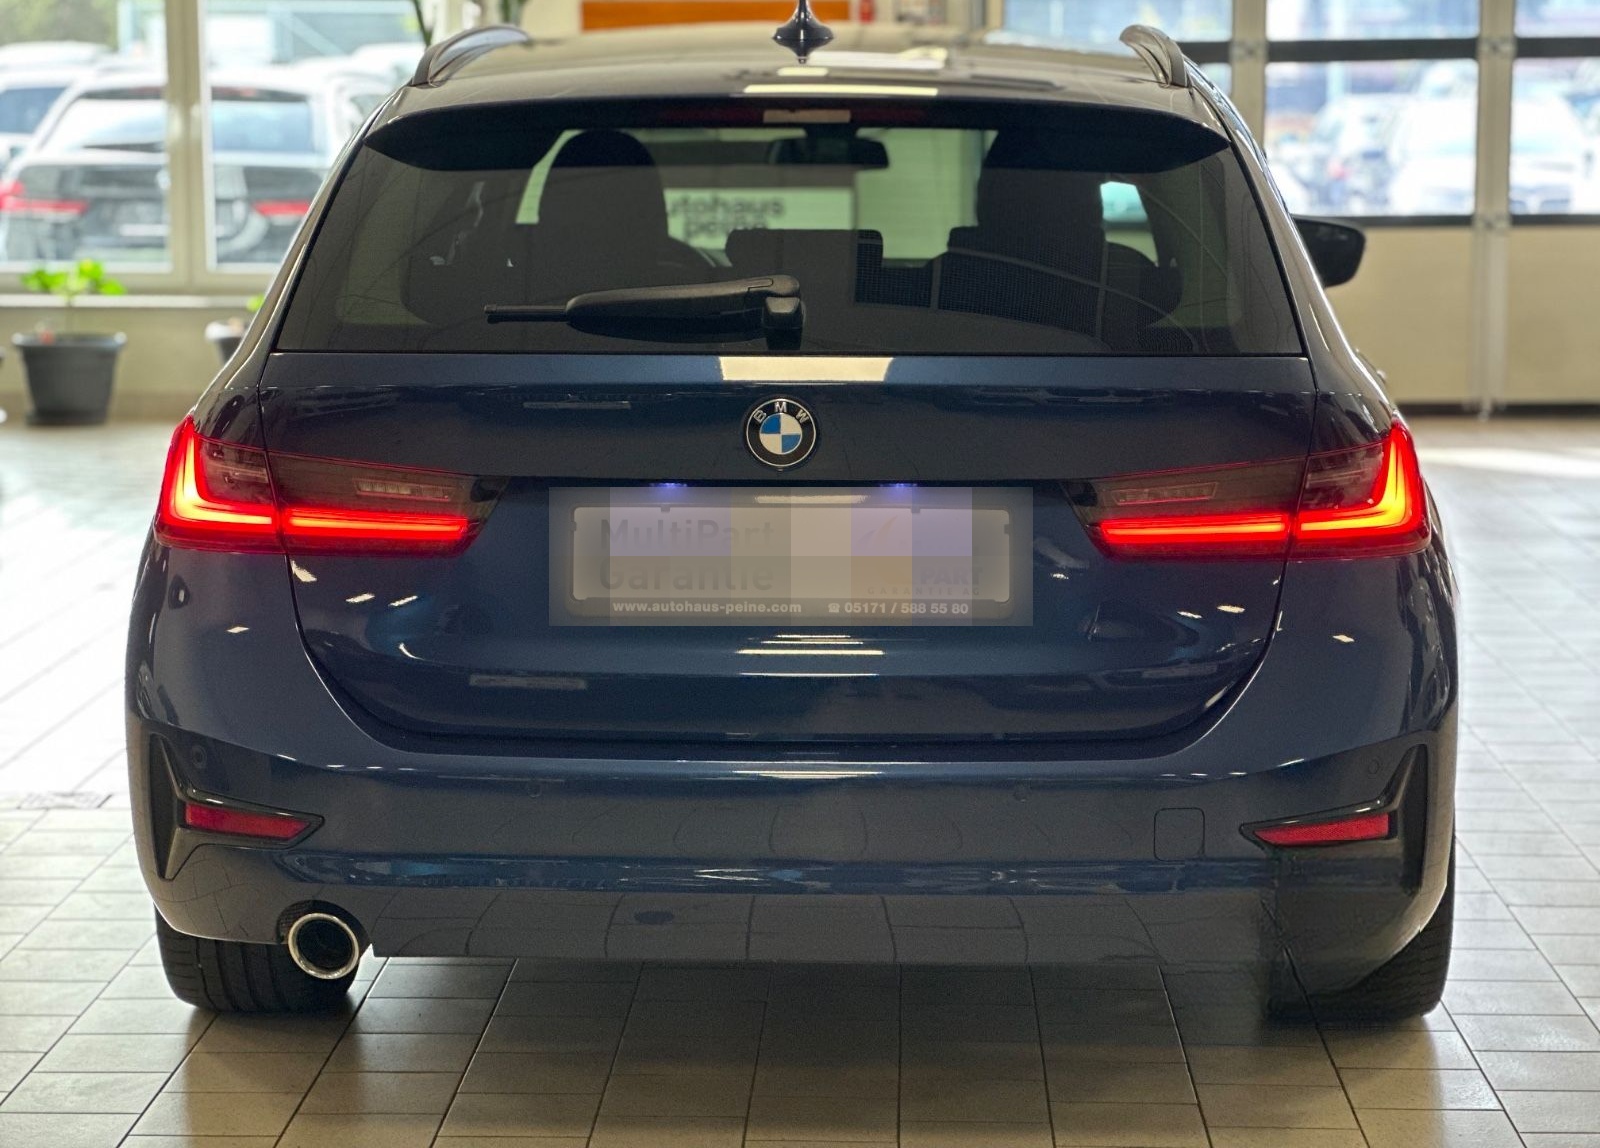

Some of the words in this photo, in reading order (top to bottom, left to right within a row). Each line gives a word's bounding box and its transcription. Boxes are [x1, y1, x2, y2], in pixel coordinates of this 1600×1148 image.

[669, 192, 784, 217] utohaus
[753, 402, 810, 424] BMW
[600, 519, 774, 550] MultiPart
[599, 557, 774, 590] Garantie
[867, 587, 953, 596] GARANTIE
[962, 587, 980, 596] AG
[612, 601, 803, 614] www.autohaus-peine.com
[844, 602, 887, 614] 05171
[900, 602, 927, 614] 588
[930, 602, 948, 614] 55
[951, 602, 969, 615] 80
